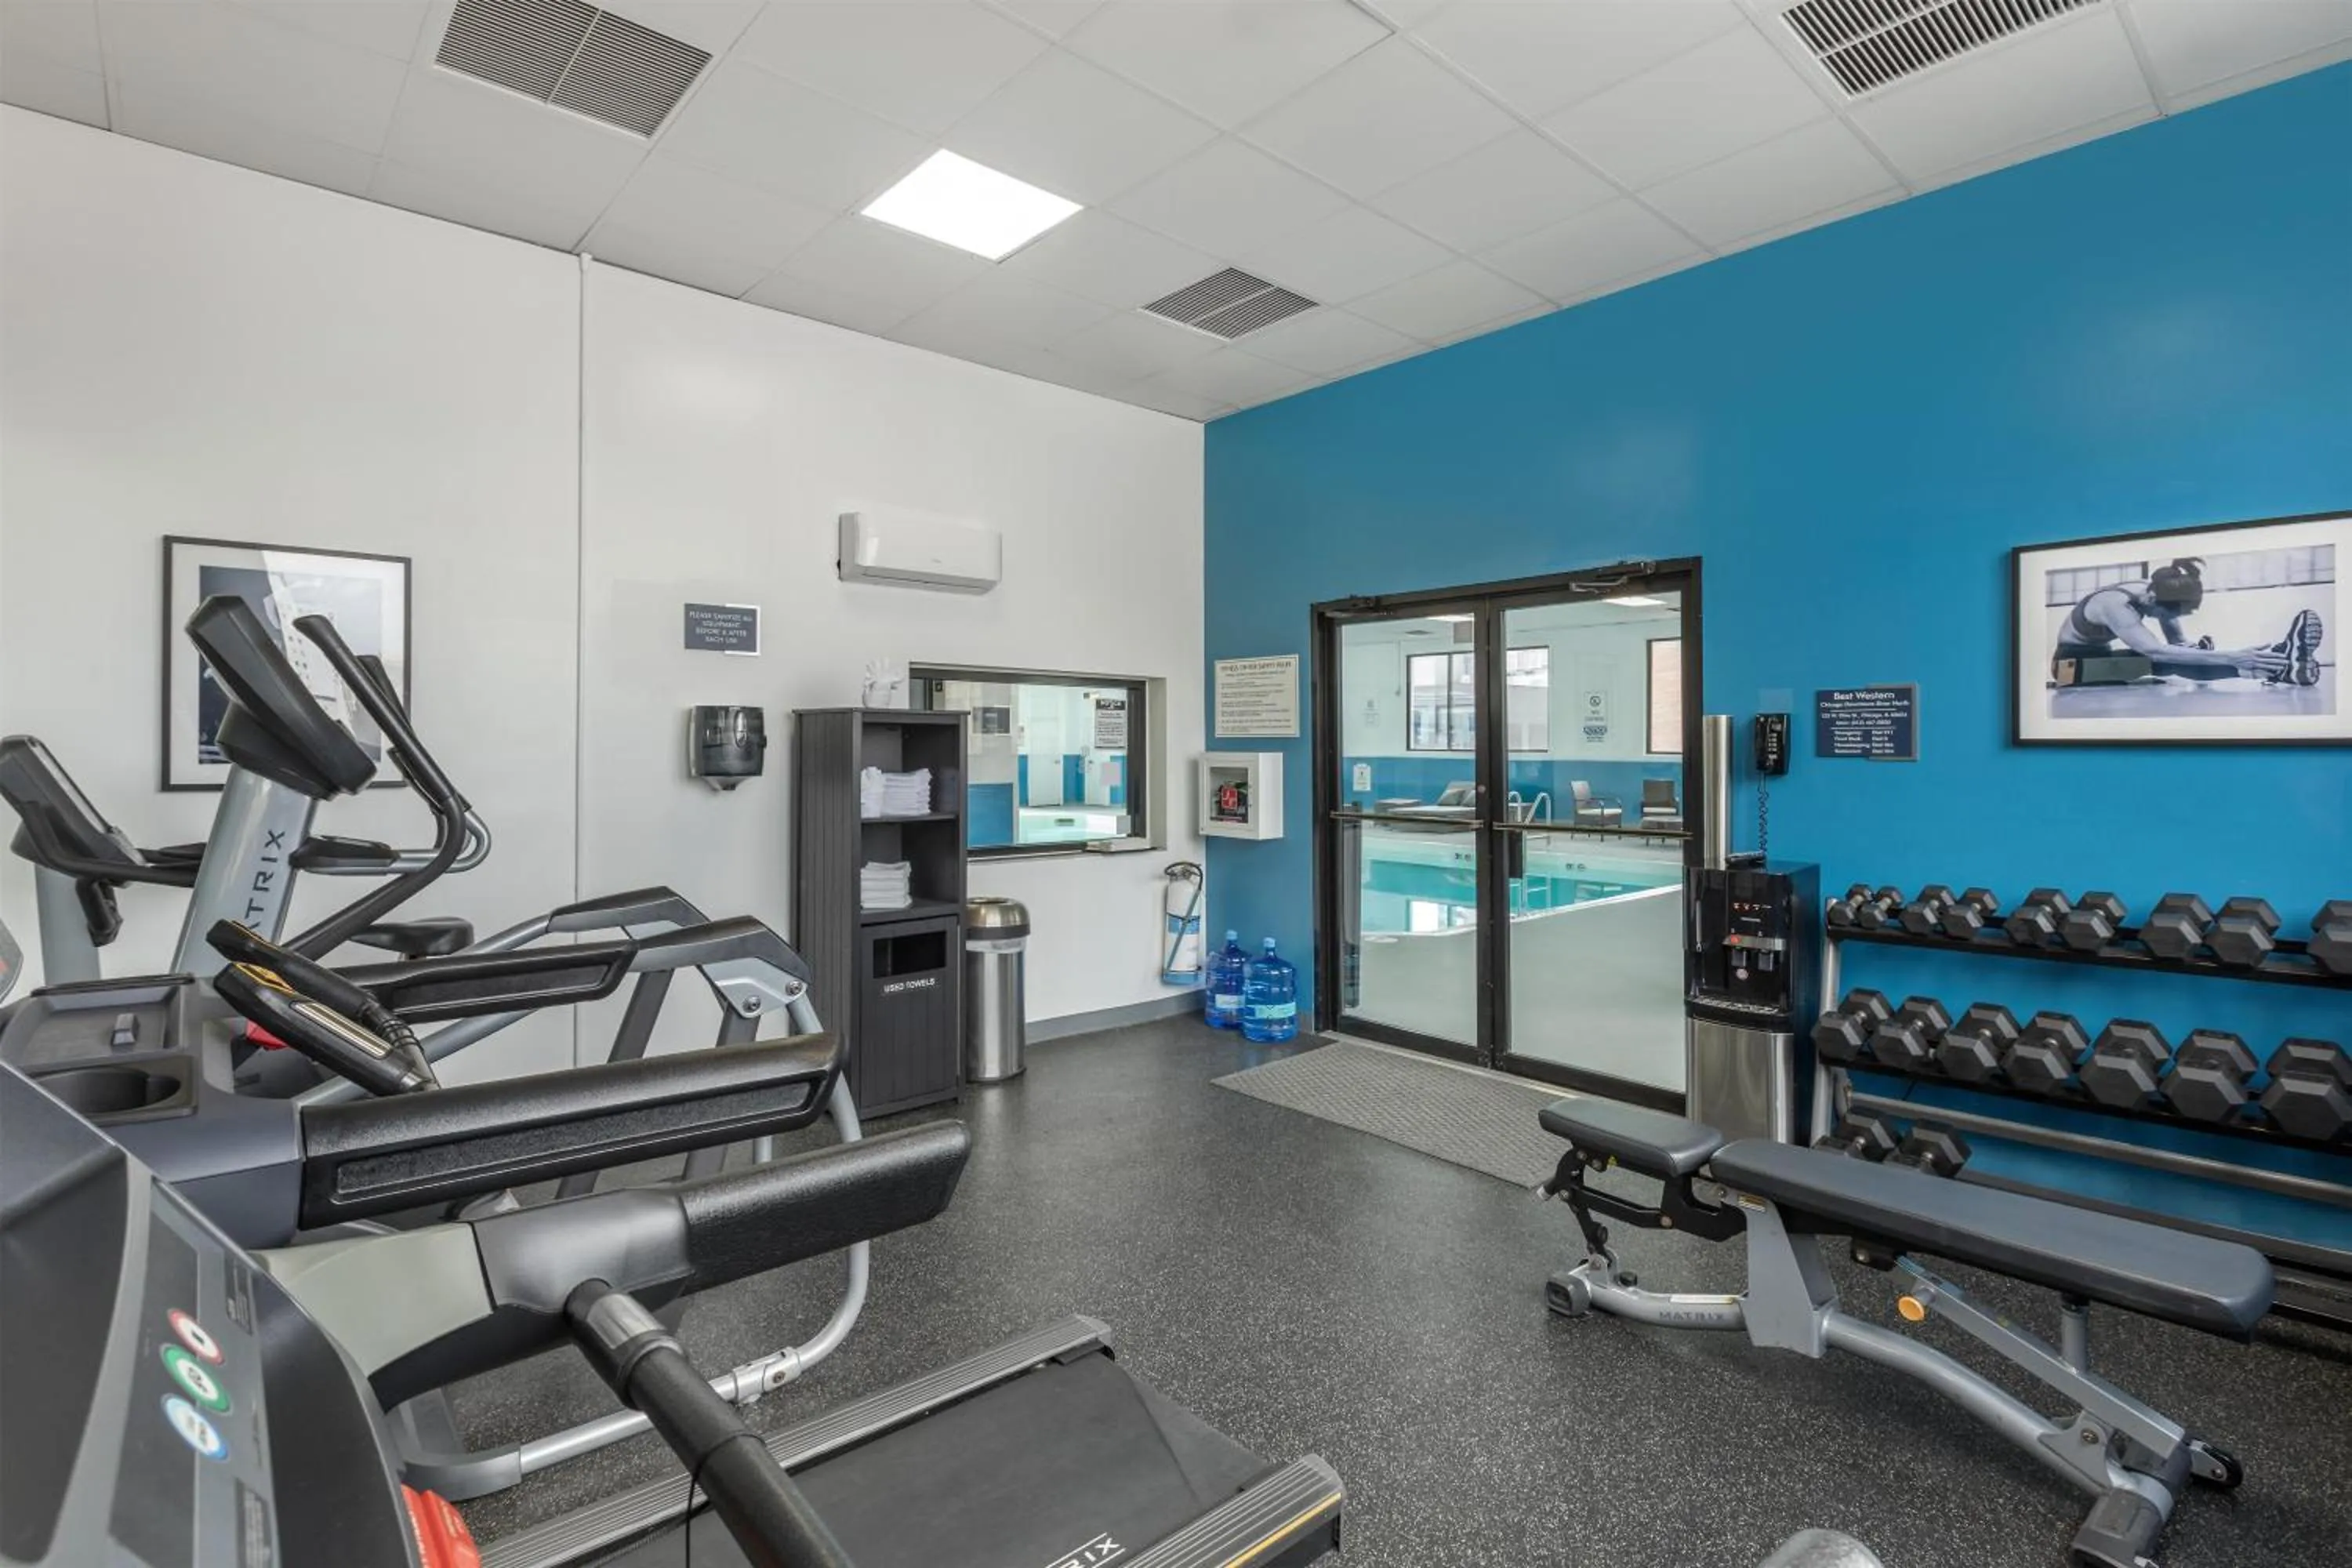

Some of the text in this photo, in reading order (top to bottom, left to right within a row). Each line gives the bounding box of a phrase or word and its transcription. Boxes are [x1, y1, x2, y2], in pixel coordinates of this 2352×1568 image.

[884, 978, 935, 993] USED TOWELS
[1660, 1311, 1724, 1320] MATRIX
